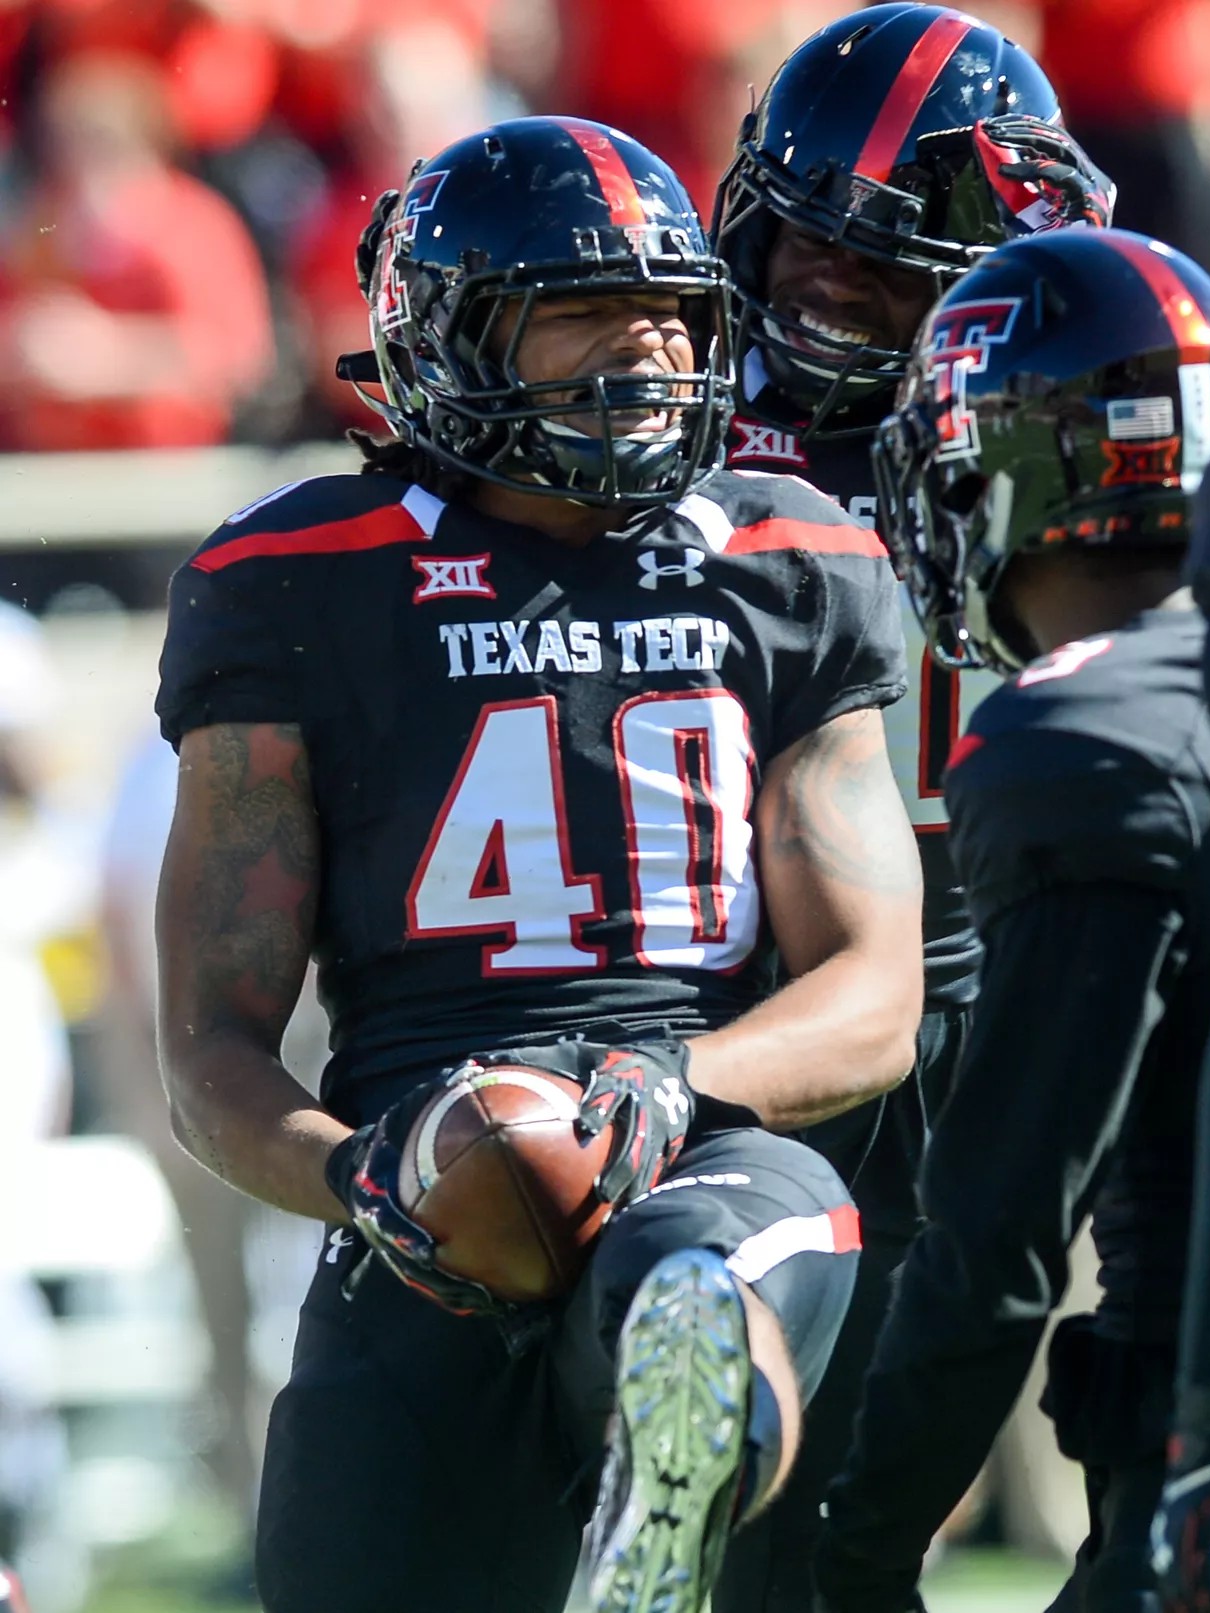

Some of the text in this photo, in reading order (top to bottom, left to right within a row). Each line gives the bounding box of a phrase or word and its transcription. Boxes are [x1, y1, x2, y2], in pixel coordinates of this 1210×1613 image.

[416, 558, 493, 600] XII
[439, 617, 731, 678] TEXAS TECH
[405, 686, 760, 979] 40
